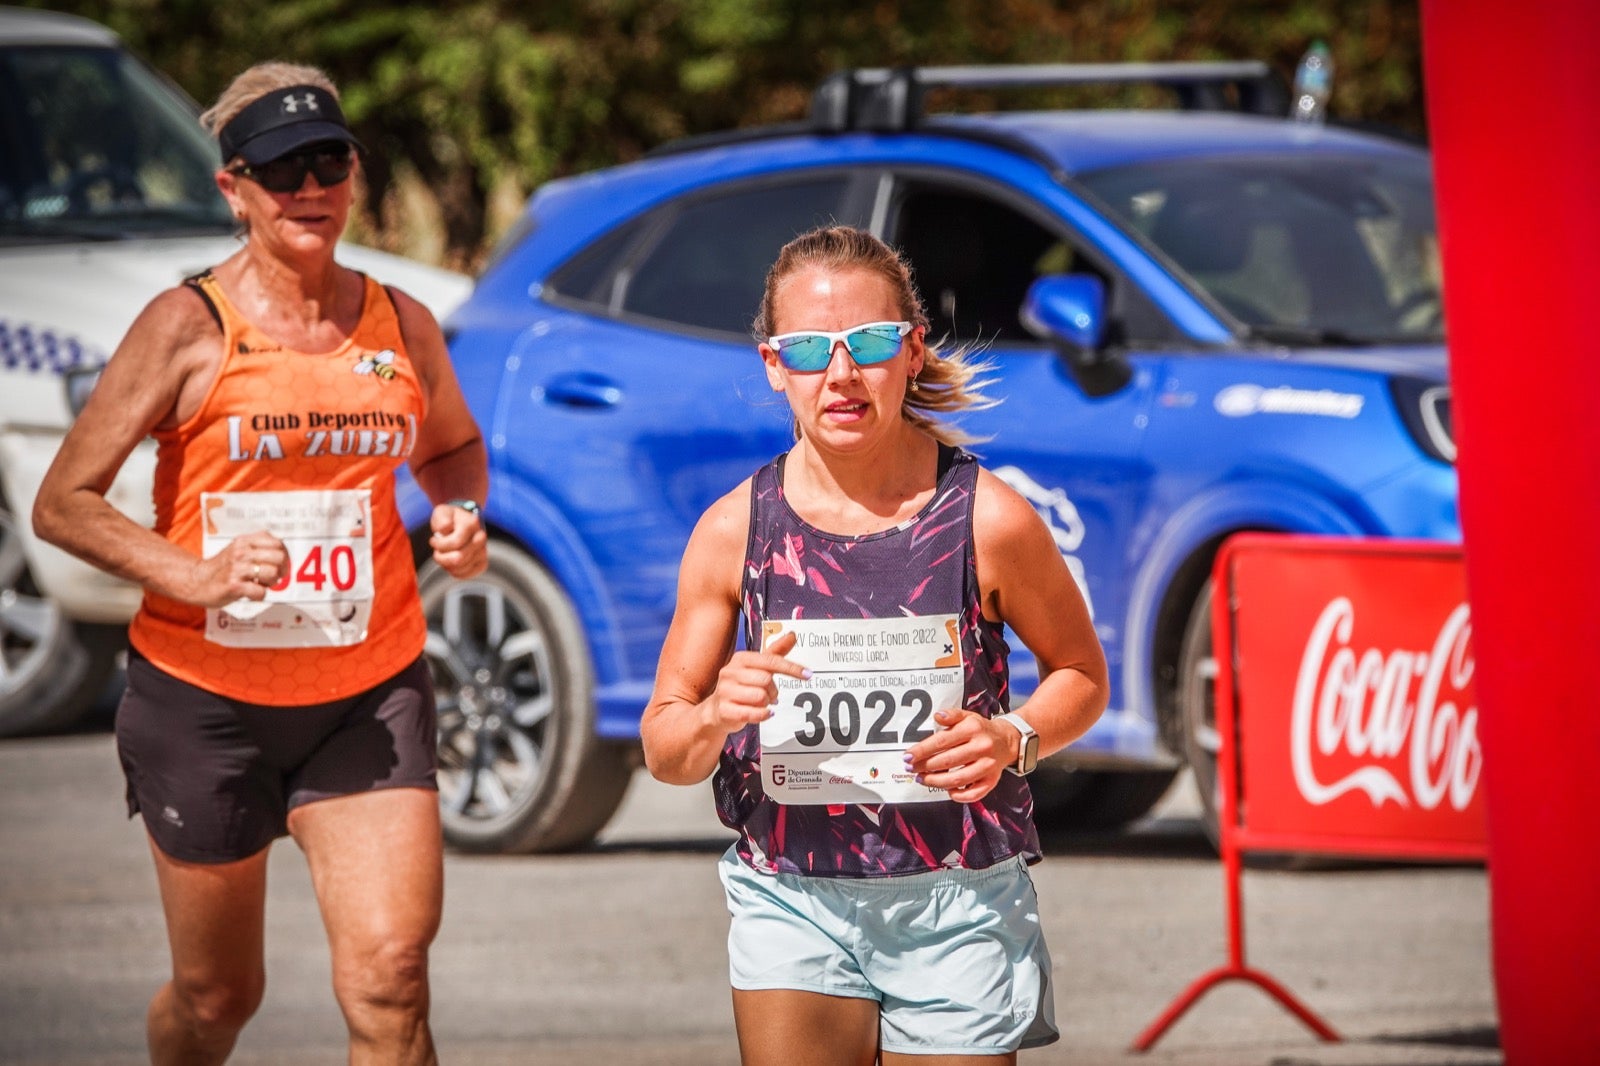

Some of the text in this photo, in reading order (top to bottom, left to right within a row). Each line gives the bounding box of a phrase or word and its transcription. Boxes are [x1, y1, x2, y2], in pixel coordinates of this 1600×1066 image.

[252, 411, 406, 431] Club Deportivo
[227, 415, 285, 462] LA
[808, 631, 830, 648] GRAN
[833, 631, 864, 647] PREMIO
[867, 633, 878, 647] DE
[880, 631, 910, 647] FONDO
[912, 628, 937, 645] 2022
[828, 649, 889, 664] UNIVERSO LORCA
[793, 688, 936, 747] 3022
